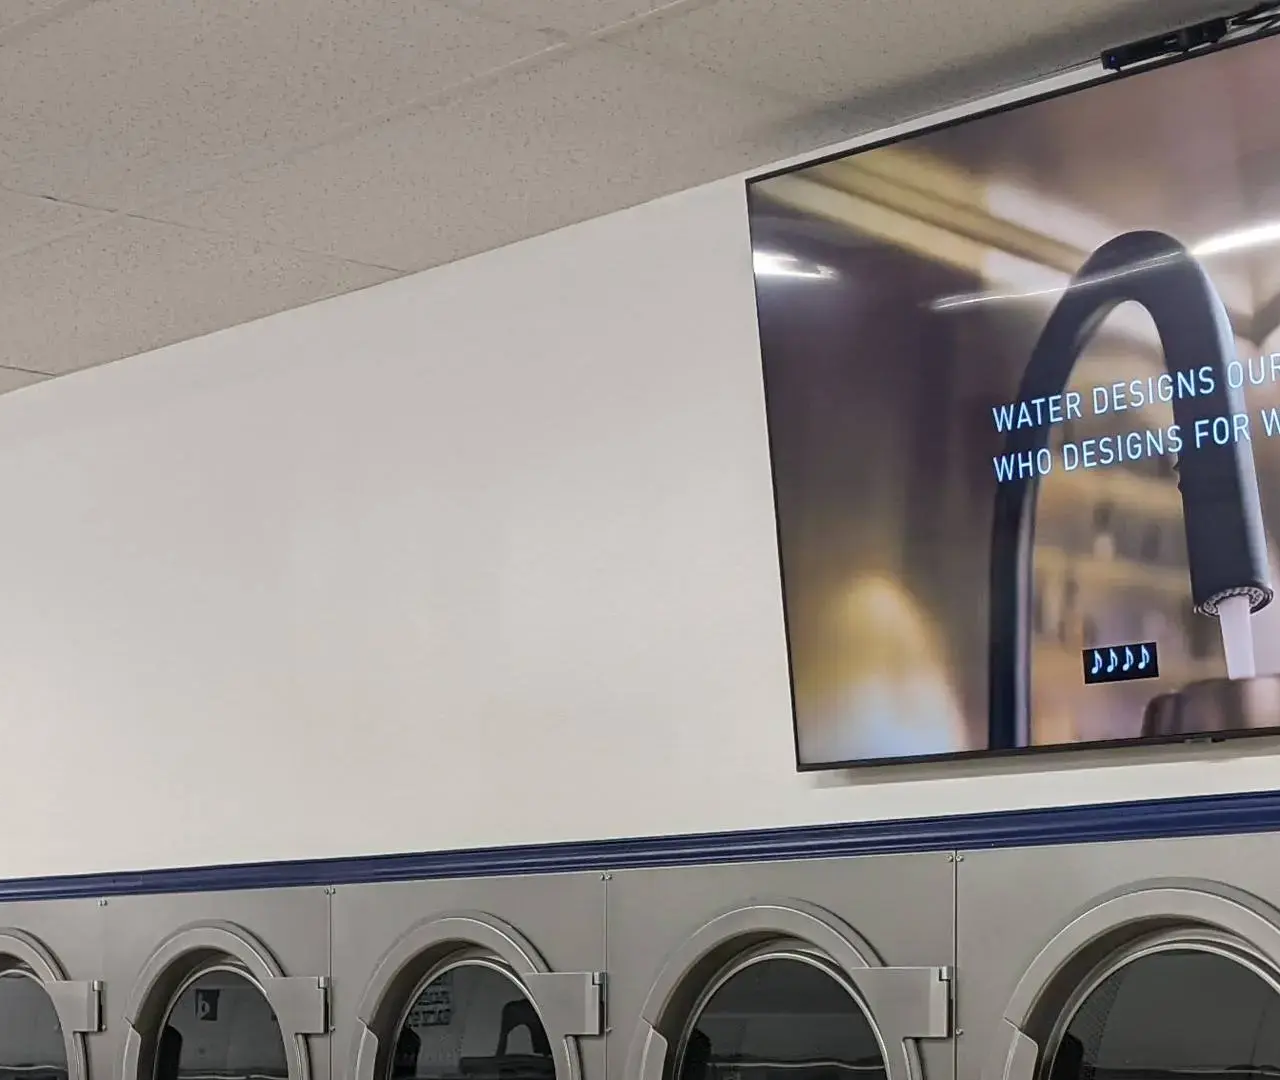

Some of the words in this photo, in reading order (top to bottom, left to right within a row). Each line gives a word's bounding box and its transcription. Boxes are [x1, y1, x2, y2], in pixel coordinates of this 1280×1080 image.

[992, 392, 1082, 433] WATER
[1092, 366, 1215, 415] DESIGNS
[993, 448, 1052, 483] WHO
[1063, 425, 1183, 471] DESIGNS
[1194, 413, 1251, 449] FOR
